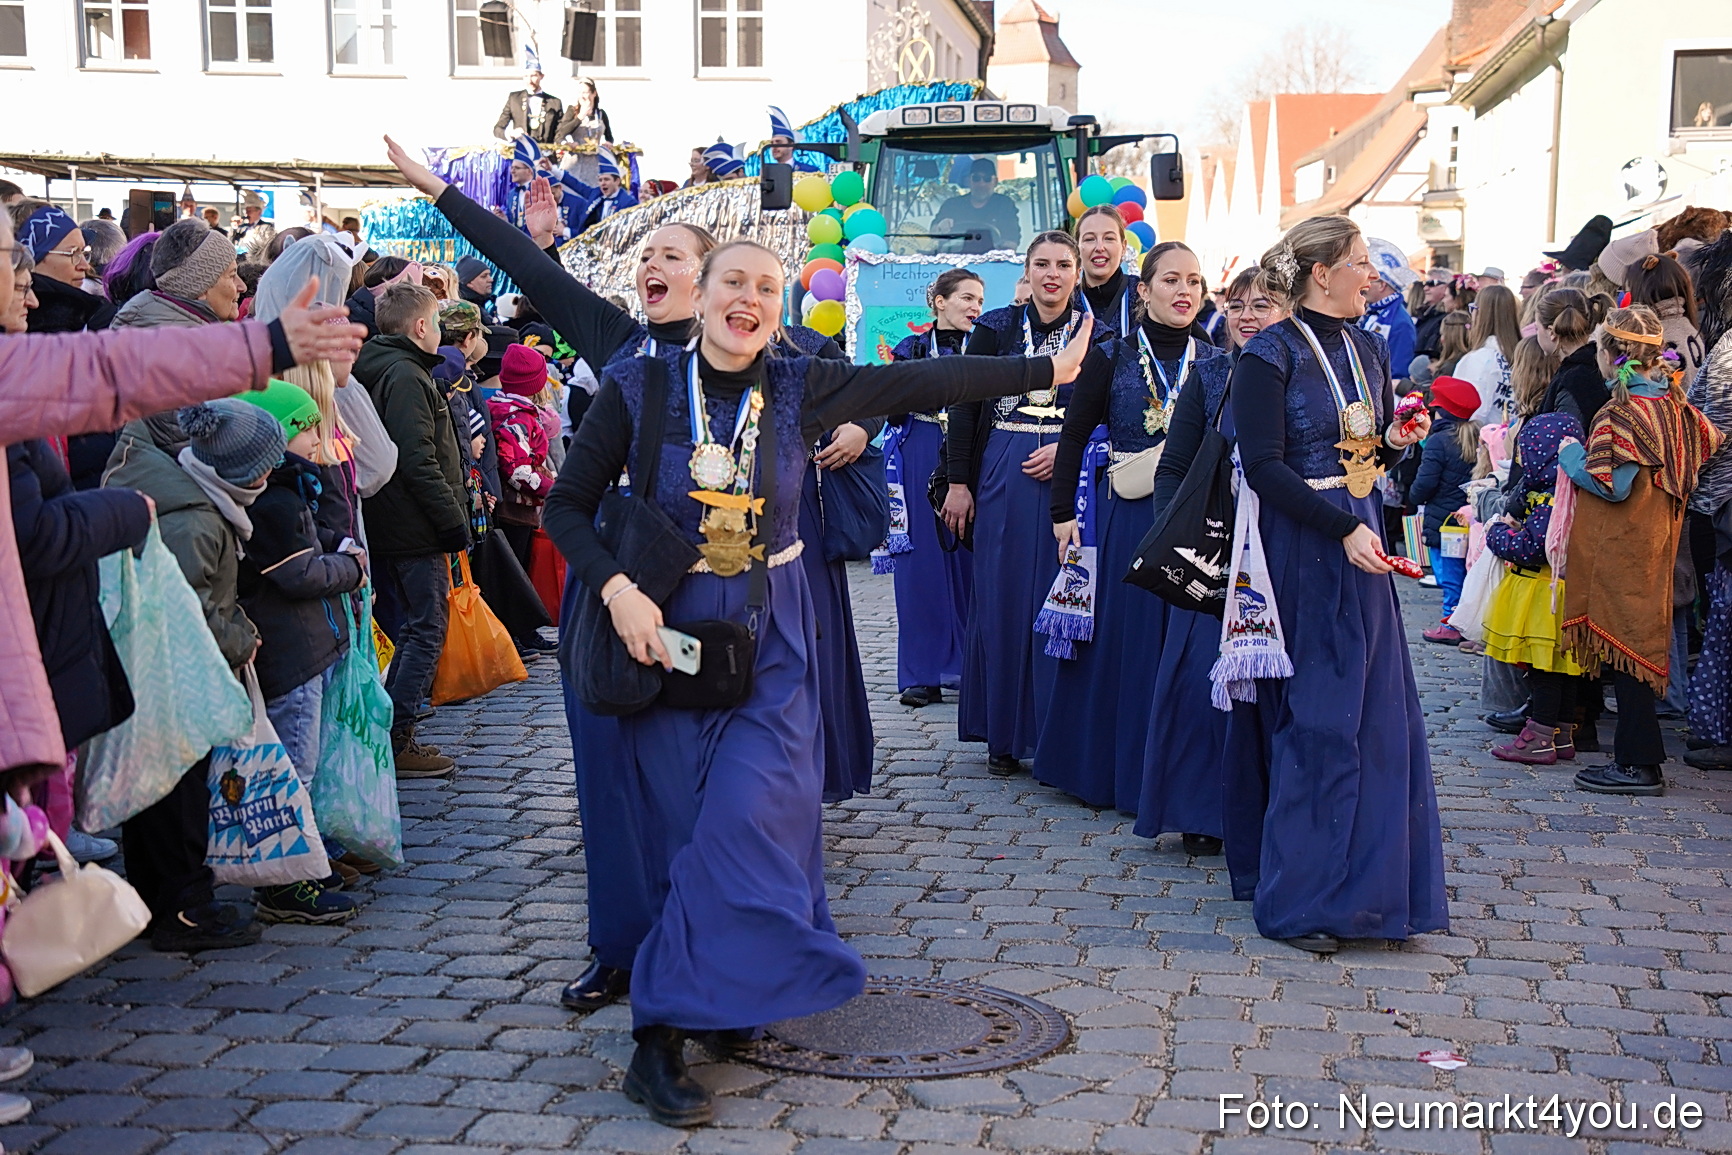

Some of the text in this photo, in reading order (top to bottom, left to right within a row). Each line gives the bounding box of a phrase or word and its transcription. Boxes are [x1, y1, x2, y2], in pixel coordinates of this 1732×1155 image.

[882, 262, 943, 280] Hechton
[1232, 638, 1269, 649] 1972-2012
[213, 797, 275, 826] Bayern
[245, 809, 293, 840] Park
